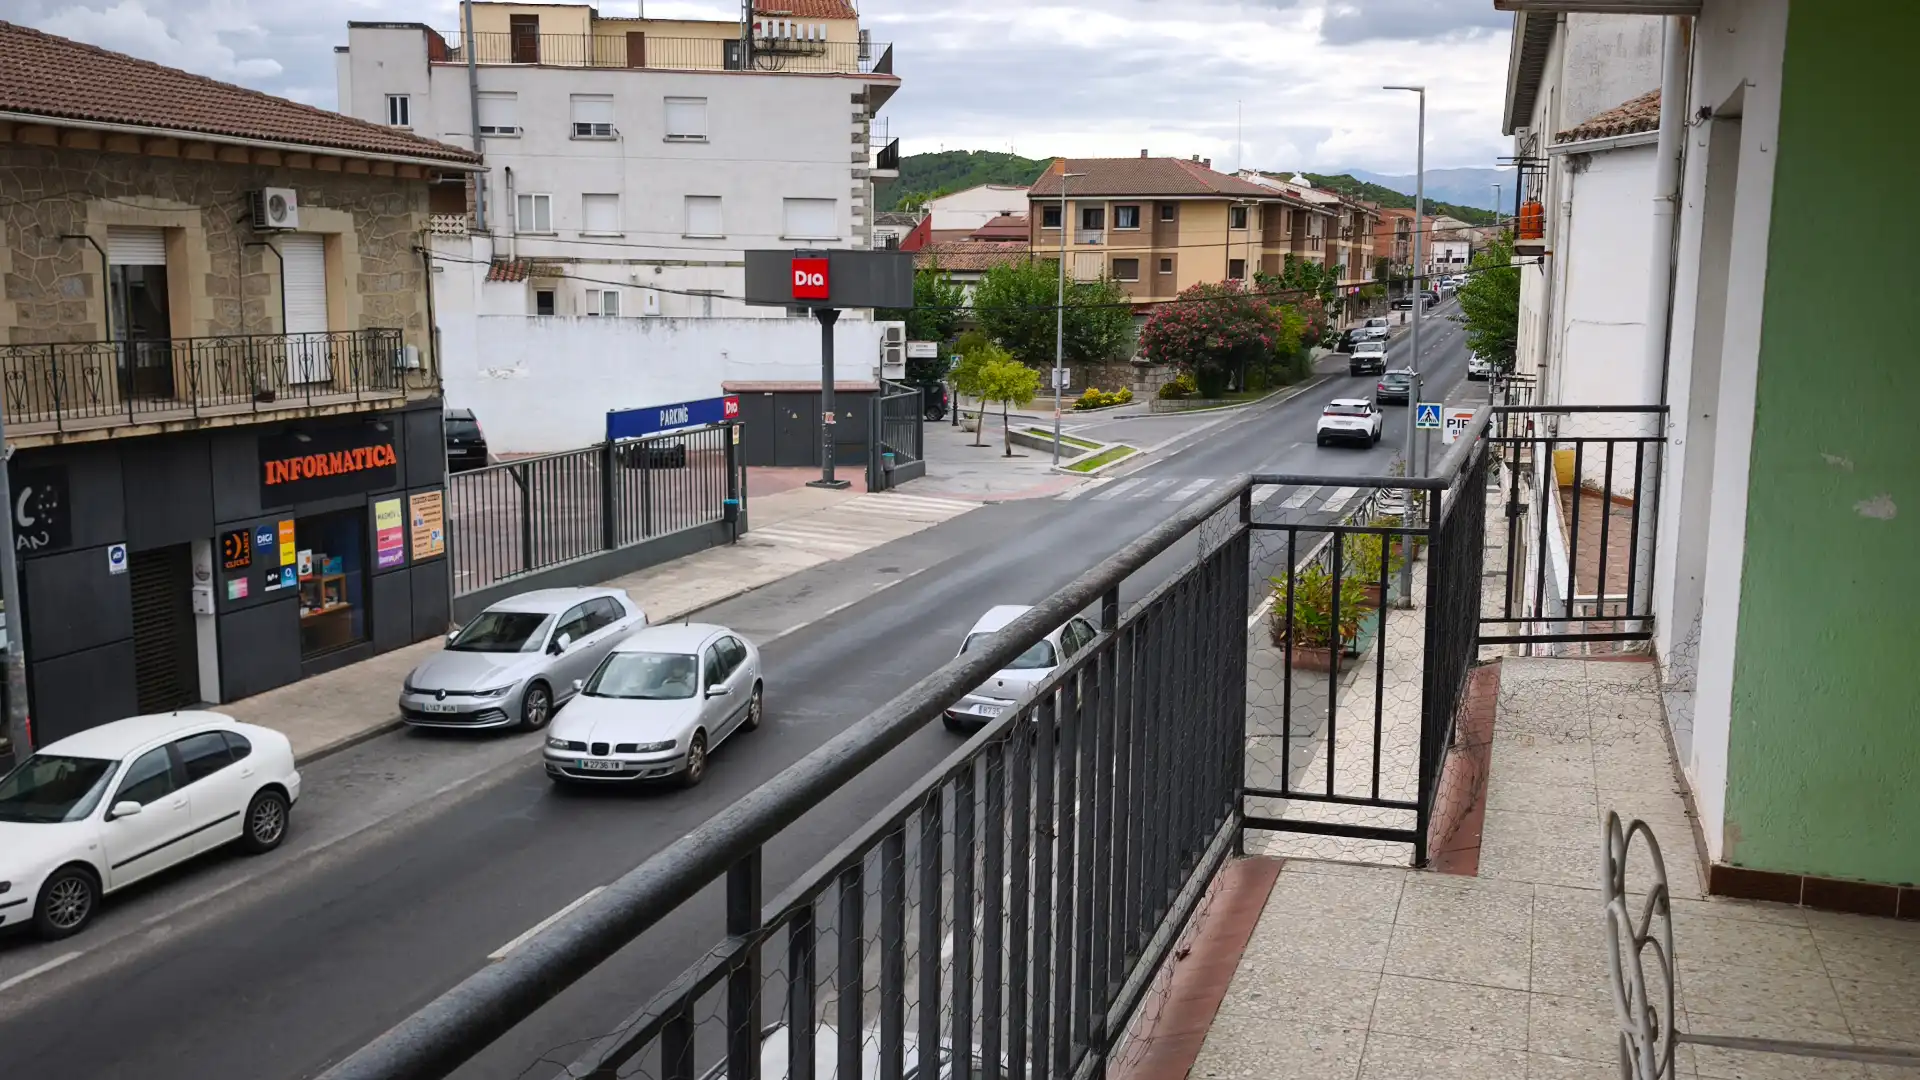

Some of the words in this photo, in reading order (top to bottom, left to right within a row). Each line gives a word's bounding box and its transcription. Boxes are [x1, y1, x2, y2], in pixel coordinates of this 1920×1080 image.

[795, 270, 825, 286] Dia
[660, 405, 689, 427] PARKING
[265, 443, 397, 485] INFORMATICA
[257, 533, 273, 544] DIGI
